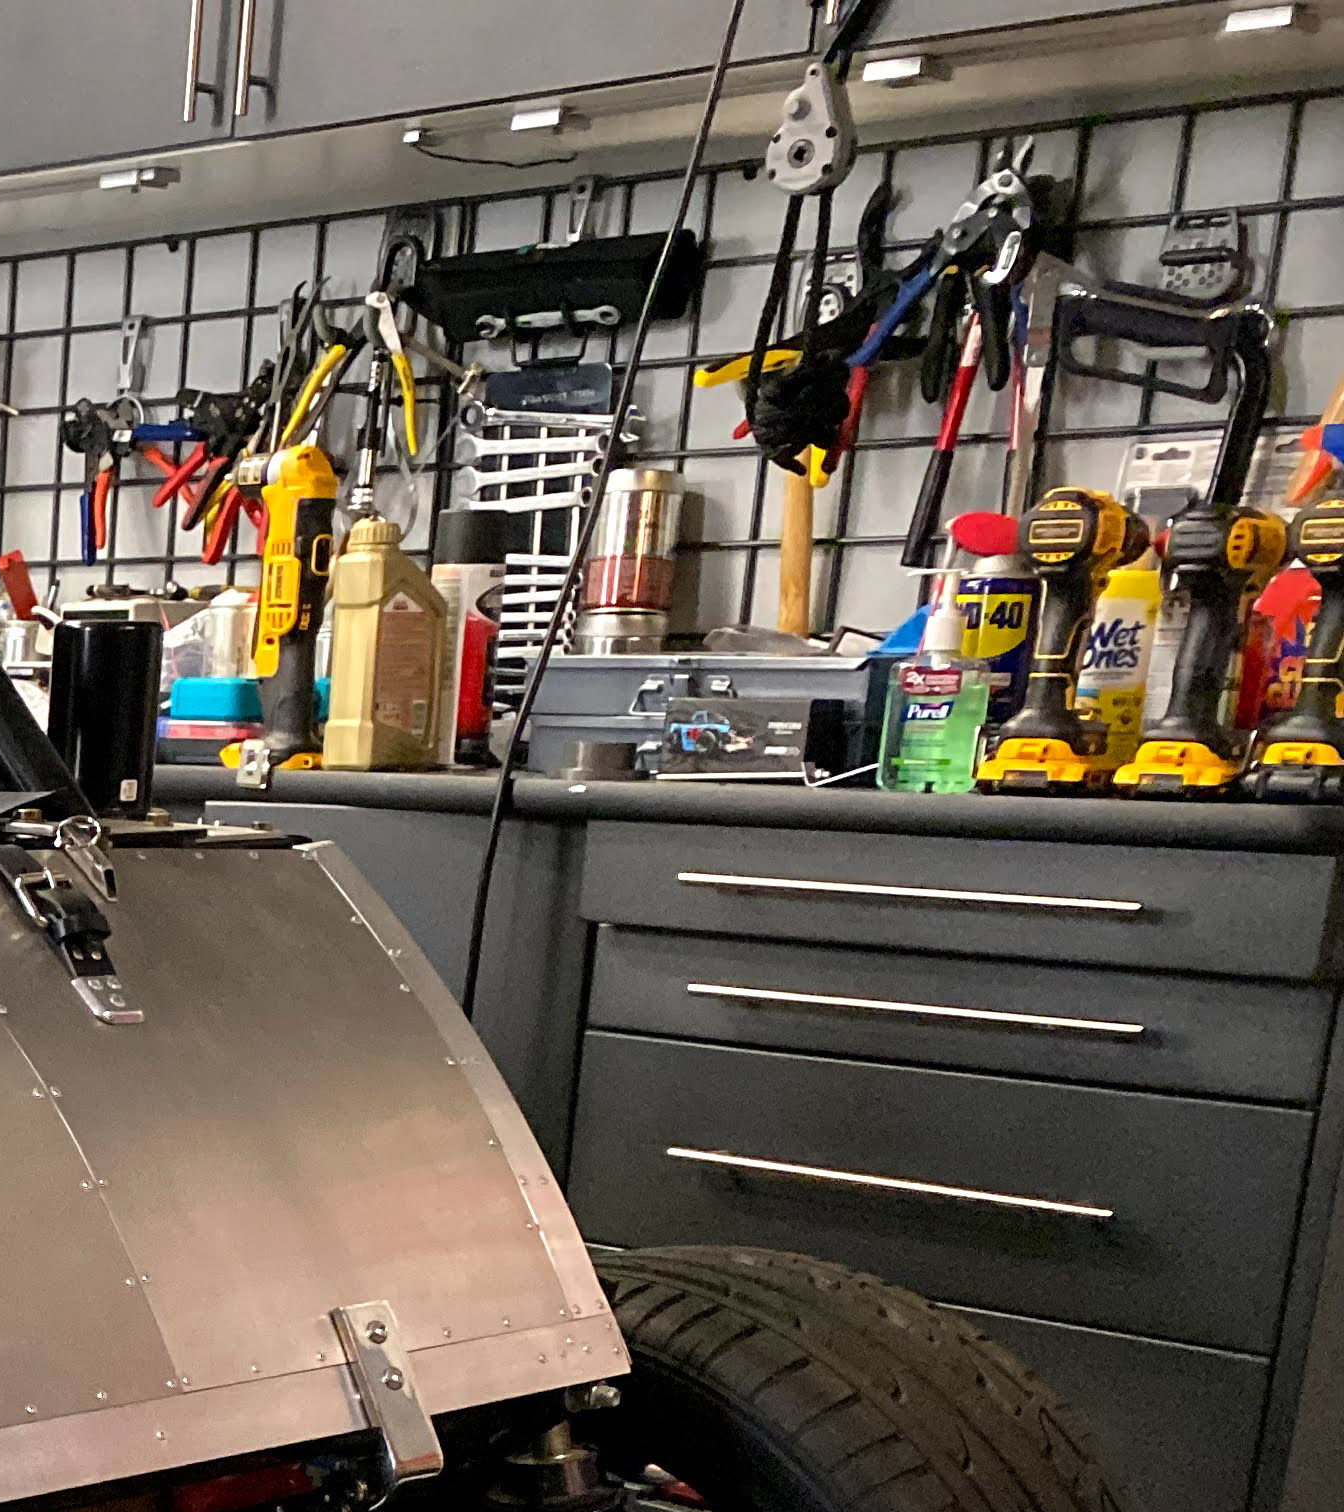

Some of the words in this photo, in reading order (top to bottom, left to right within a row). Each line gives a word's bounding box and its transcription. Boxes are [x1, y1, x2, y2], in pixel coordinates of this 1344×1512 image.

[959, 601, 1025, 630] D-40
[1086, 618, 1146, 650] Wet
[906, 703, 951, 719] Purell
